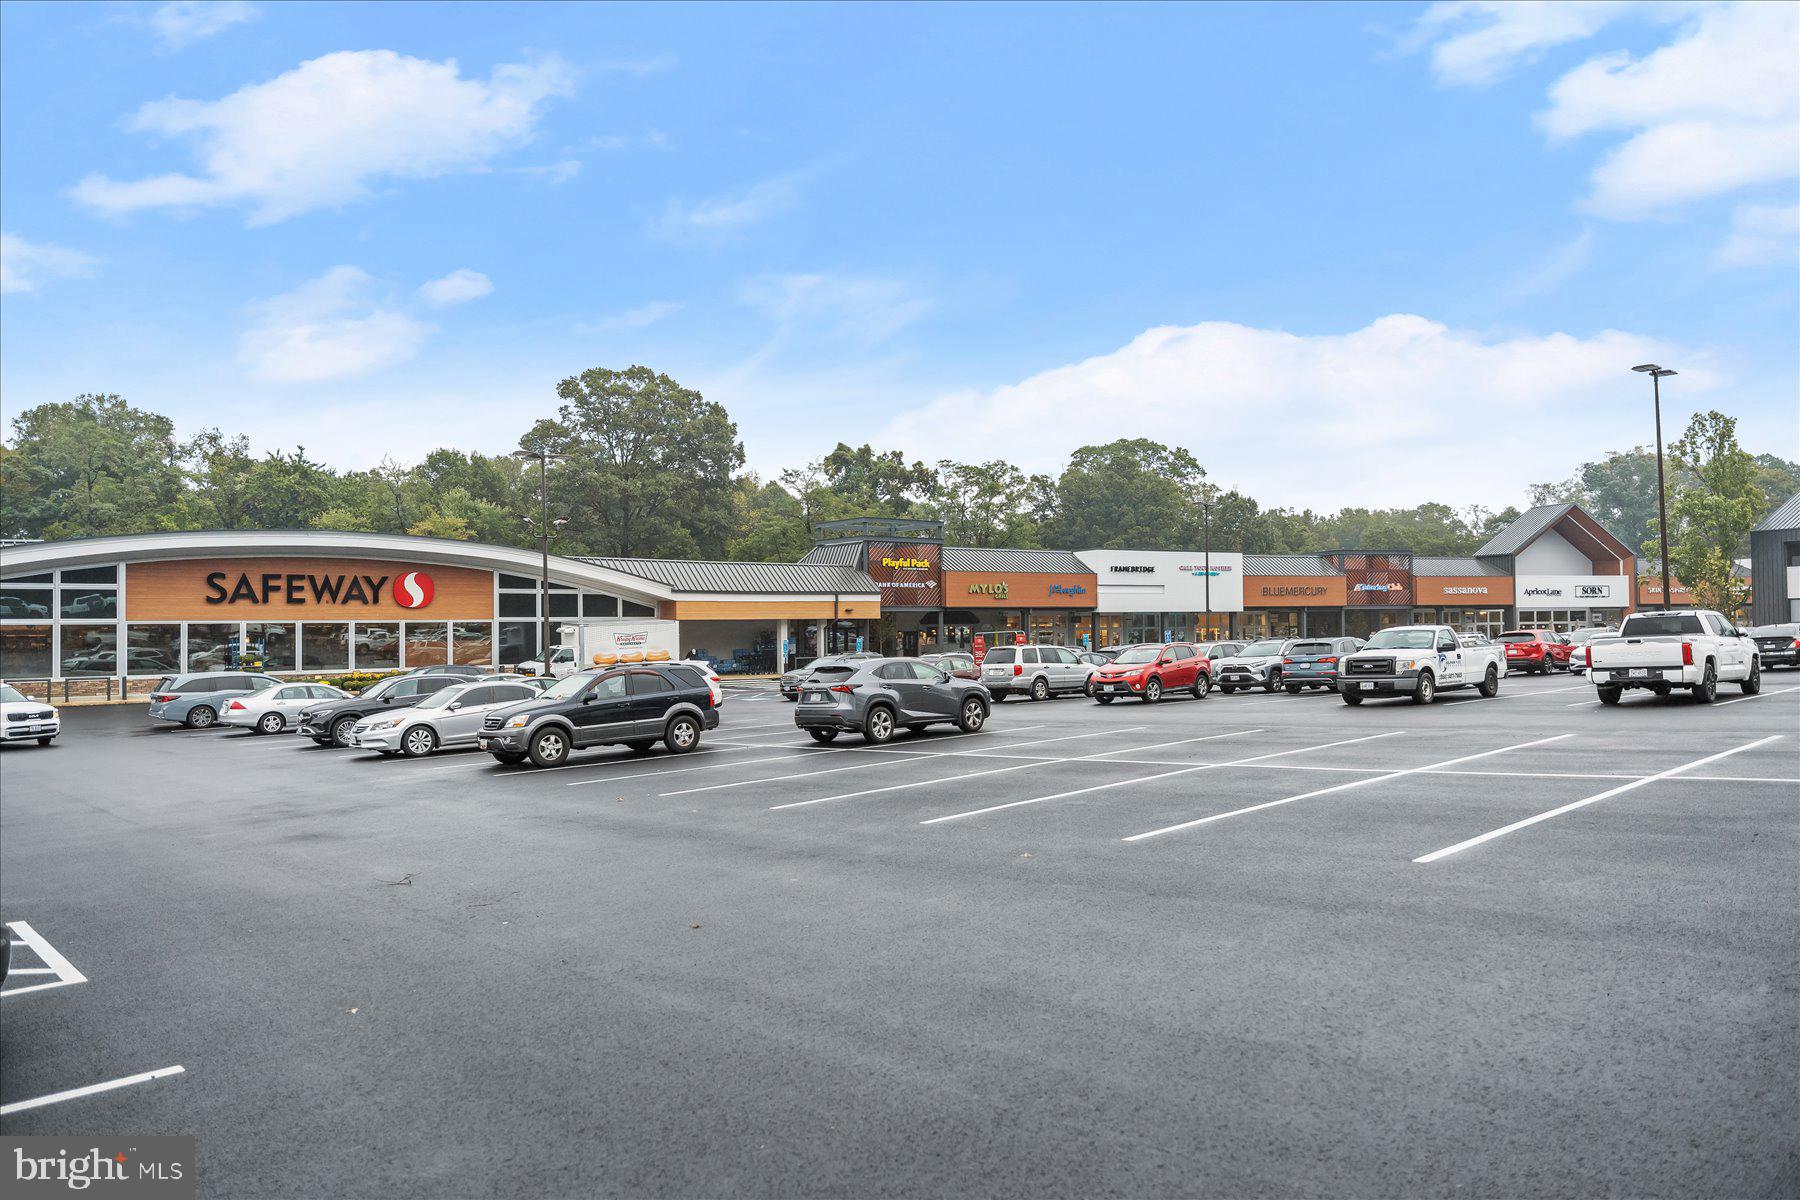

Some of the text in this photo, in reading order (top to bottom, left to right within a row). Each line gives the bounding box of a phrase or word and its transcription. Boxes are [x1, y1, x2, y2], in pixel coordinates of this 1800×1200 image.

[882, 557, 931, 570] Playful Pack
[1110, 565, 1156, 573] FRAMEBRIDGE
[205, 572, 389, 605] SAFEWAY
[1262, 586, 1328, 597] BLUEMERCURY
[1443, 586, 1488, 595] sassanova
[1581, 586, 1603, 595] SORN
